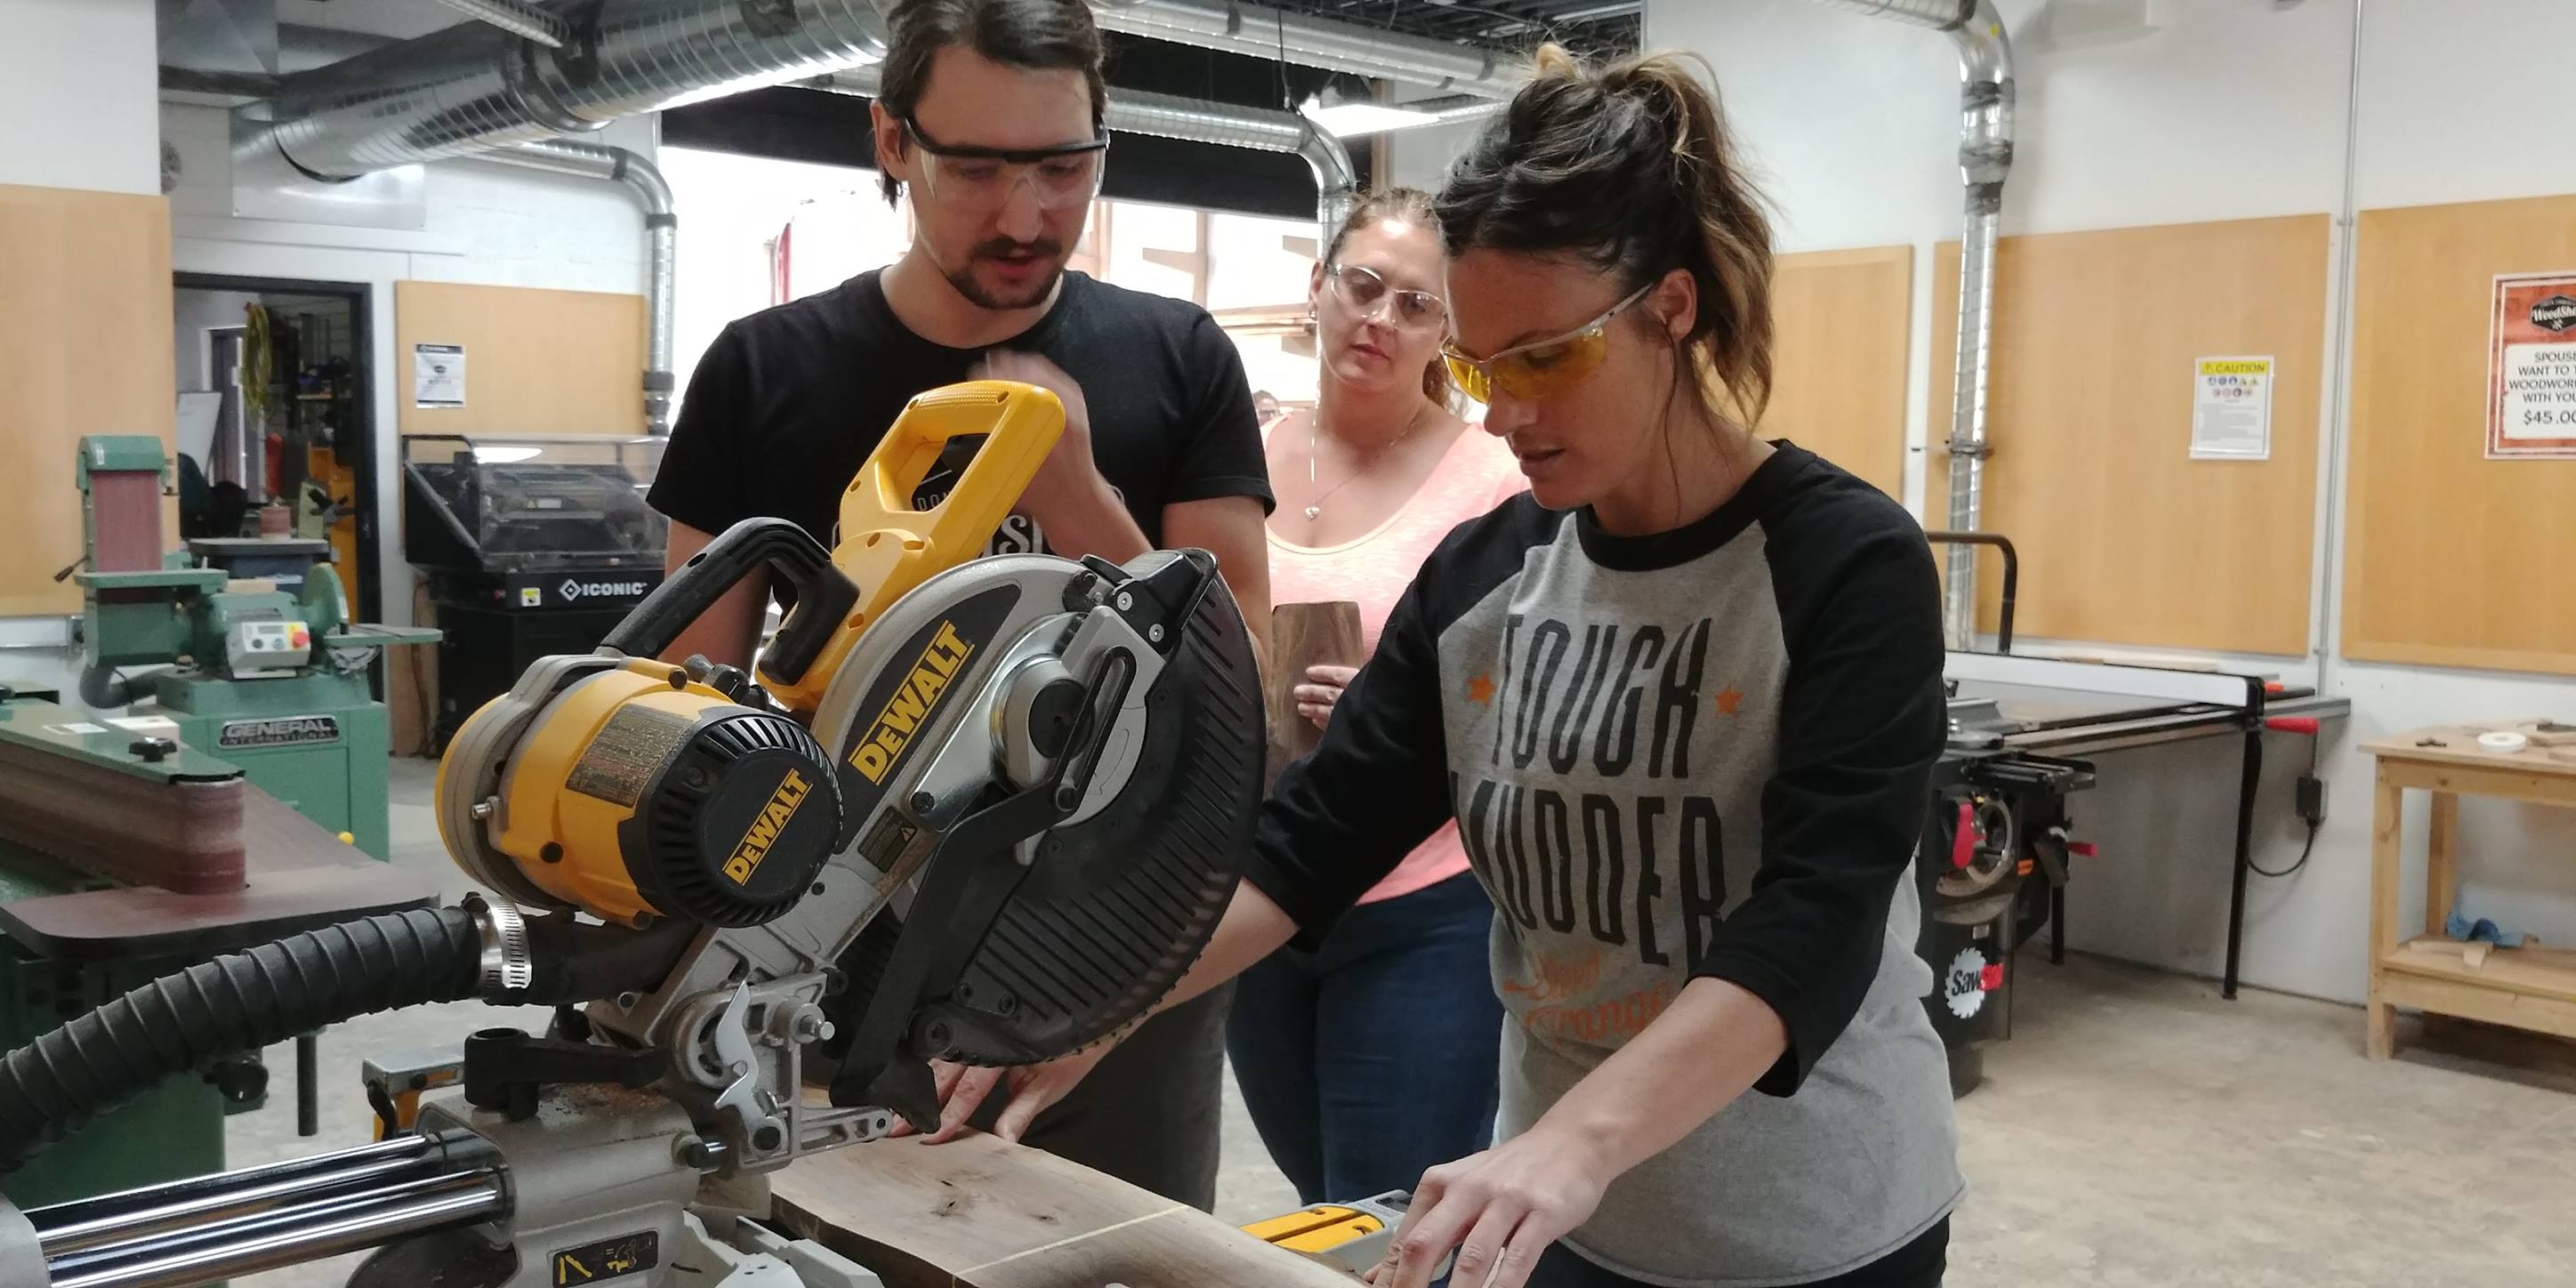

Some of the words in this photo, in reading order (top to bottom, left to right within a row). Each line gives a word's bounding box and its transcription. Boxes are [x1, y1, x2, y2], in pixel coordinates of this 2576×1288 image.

[2215, 363, 2265, 374] CAUTION
[2518, 366, 2548, 375] WANT
[2555, 365, 2570, 375] TO
[2508, 379, 2576, 390] WOODWOR
[2523, 392, 2551, 402] WITH
[583, 583, 643, 596] ICONIC
[850, 623, 969, 784] DEWALT
[1492, 614, 1711, 778] TOUGH
[226, 720, 331, 737] GENERAL
[724, 769, 809, 884] DEWALT
[1450, 770, 1726, 977] MUDDER
